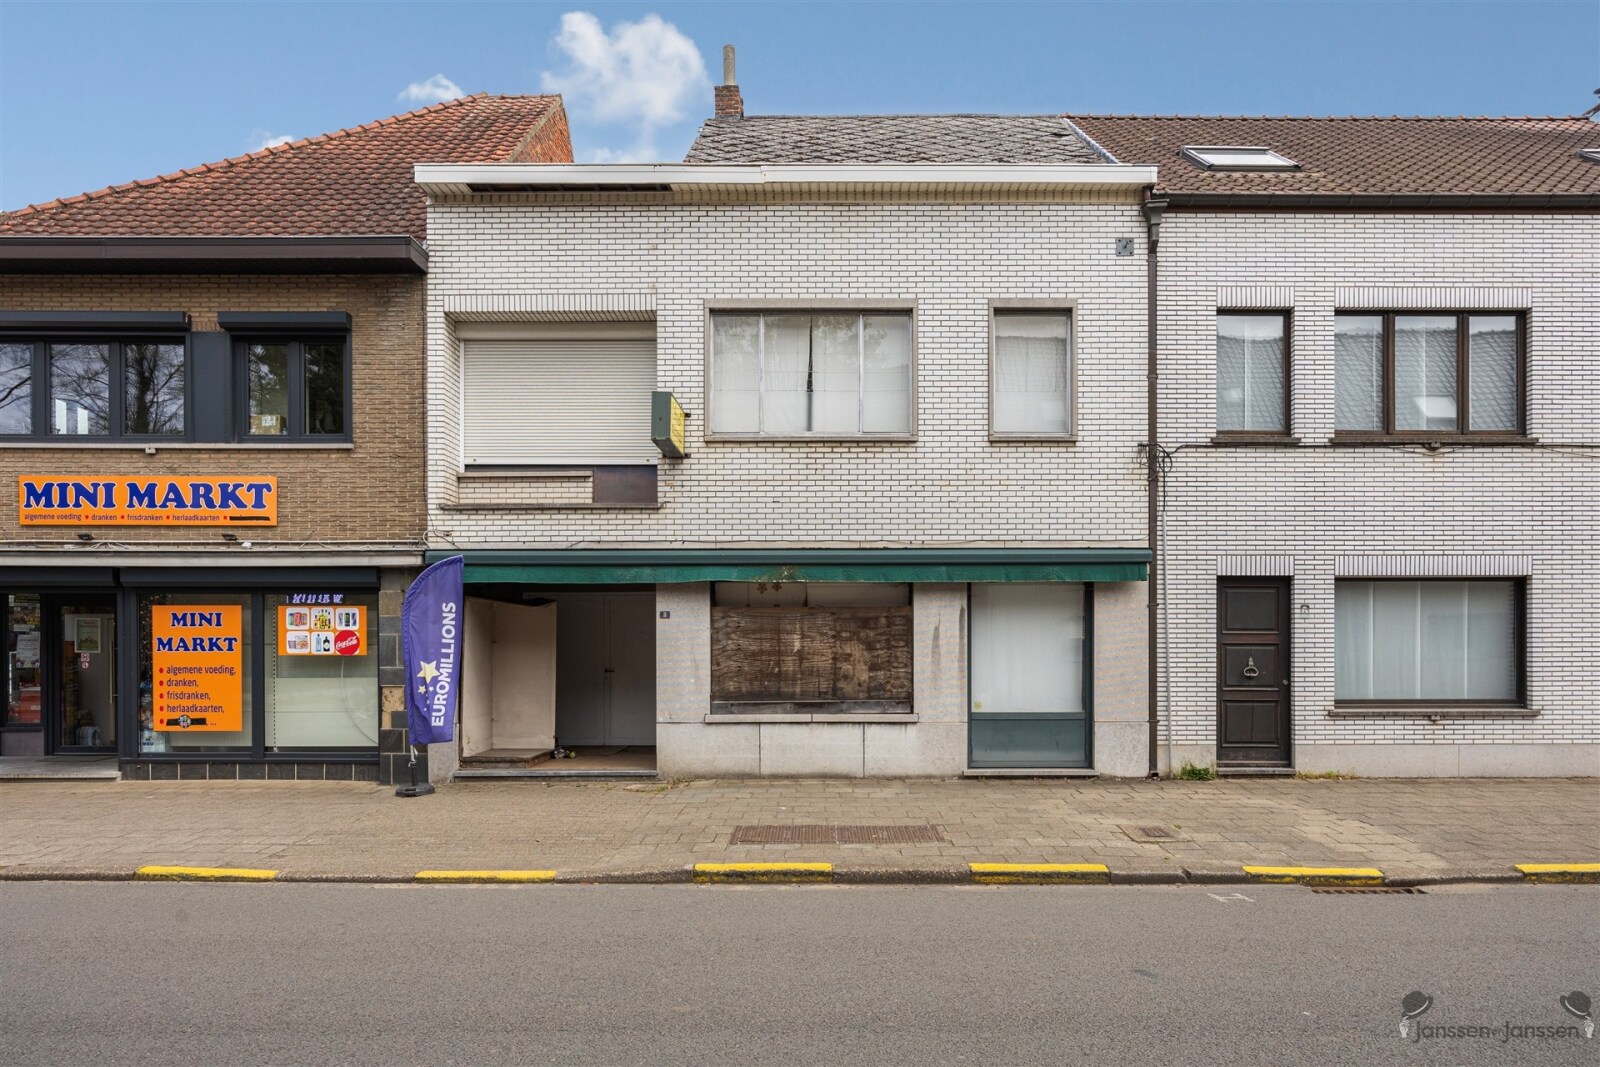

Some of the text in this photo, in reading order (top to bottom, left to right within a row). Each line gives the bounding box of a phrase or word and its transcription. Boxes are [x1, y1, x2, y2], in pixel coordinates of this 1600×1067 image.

[23, 482, 273, 509] MINI MARKT
[24, 512, 220, 522] algemene voeding dranken frisdranken herlaadkaarten
[171, 612, 223, 627] MINI
[156, 637, 238, 652] MARKT
[431, 602, 457, 727] EUROMILLIONS
[166, 665, 236, 676] algemene voeding,
[166, 679, 199, 688] dranken,
[166, 691, 211, 700] frisdranken,
[166, 704, 225, 713] herlaadkaarten,
